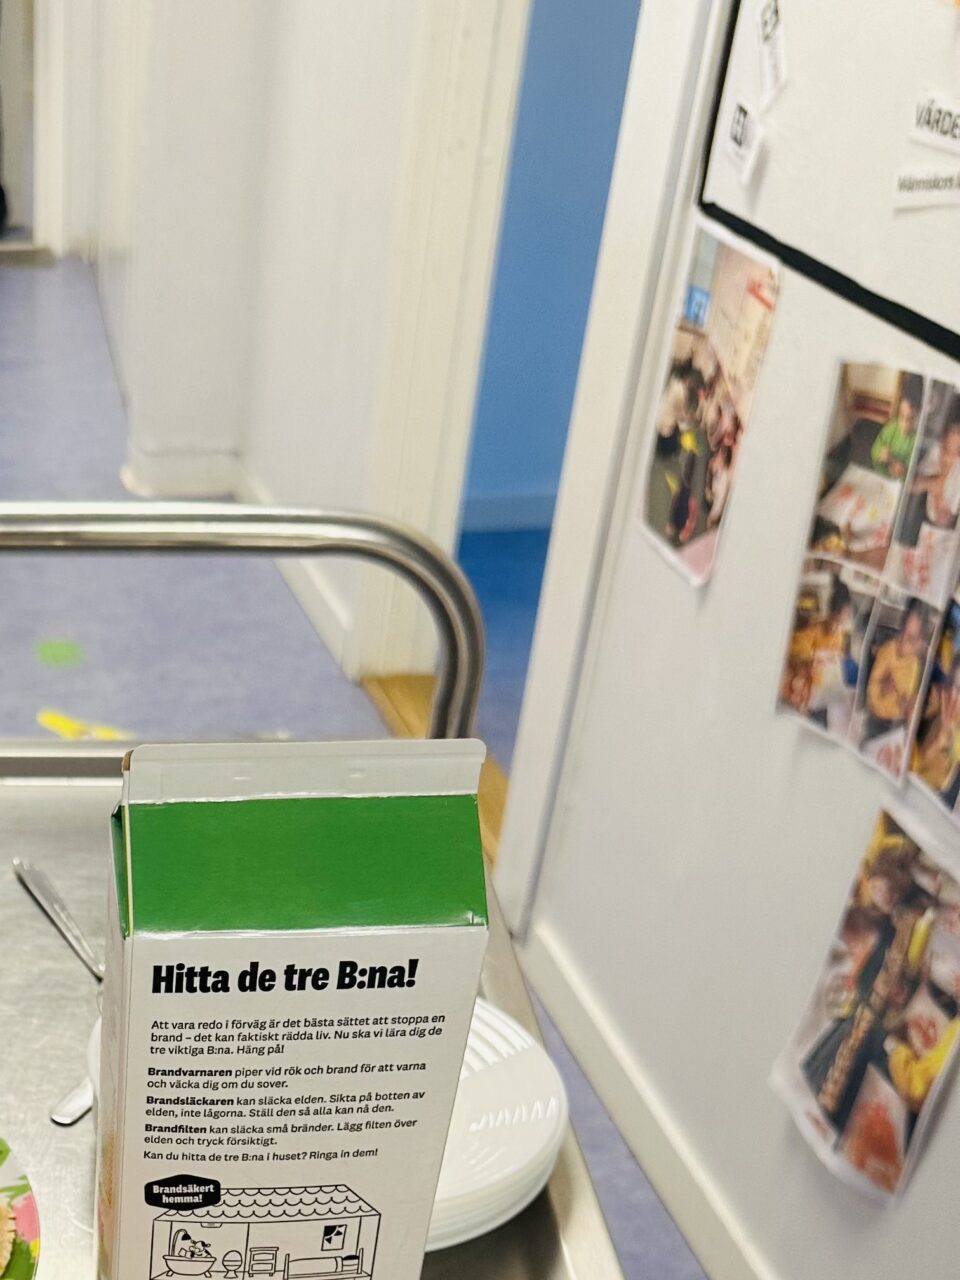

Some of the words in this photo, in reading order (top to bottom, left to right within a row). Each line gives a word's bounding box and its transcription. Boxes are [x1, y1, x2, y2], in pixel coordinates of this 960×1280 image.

[152, 963, 230, 994] Hitta
[237, 961, 276, 993] de
[283, 964, 329, 991] tre
[336, 958, 419, 989] B:na!
[151, 1020, 169, 1030] Att
[171, 1022, 195, 1030] vara
[198, 1020, 222, 1030] redo
[226, 1020, 229, 1029] i
[231, 1020, 266, 1030] förväg
[269, 1019, 280, 1028] är
[282, 1018, 300, 1028] det
[304, 1018, 334, 1027] bästa
[337, 1017, 370, 1026] sättet
[372, 1016, 388, 1025] att
[391, 1016, 429, 1025] stoppa
[150, 1033, 182, 1042] brand
[194, 1033, 212, 1042] det
[215, 1033, 234, 1042] kan
[237, 1032, 279, 1042] faktiskt
[282, 1031, 313, 1040] rädda
[316, 1030, 331, 1040] liv.
[334, 1030, 349, 1039] Nu
[352, 1029, 370, 1038] ska
[374, 1029, 383, 1038] vi
[386, 1028, 406, 1037] lära
[409, 1027, 426, 1038] dig
[428, 1027, 442, 1035] de
[150, 1046, 166, 1054] tre
[168, 1046, 204, 1056] viktiga
[207, 1046, 234, 1054] B:na.
[237, 1045, 265, 1055] Häng
[267, 1044, 284, 1055] på!
[148, 1068, 232, 1076] Brandvarnaren
[235, 1069, 263, 1078] piper
[265, 1067, 282, 1076] vid
[284, 1066, 302, 1075] rök
[304, 1066, 323, 1074] och
[326, 1065, 358, 1074] brand
[360, 1064, 376, 1073] för
[378, 1064, 394, 1072] att
[396, 1063, 426, 1071] varna
[147, 1080, 166, 1088] och
[170, 1080, 200, 1088] väcka
[202, 1080, 219, 1090] dig
[221, 1081, 238, 1089] om
[241, 1080, 254, 1088] du
[146, 1096, 234, 1106] Brandsläckaren
[236, 1097, 255, 1106] kan
[258, 1096, 292, 1104] släcka
[294, 1095, 326, 1104] elden.
[330, 1094, 356, 1103] Sikta
[359, 1092, 372, 1103] på
[375, 1092, 410, 1101] botten
[412, 1091, 425, 1099] av
[146, 1108, 178, 1118] elden,
[181, 1109, 201, 1117] inte
[204, 1109, 246, 1119] lågorna.
[249, 1108, 273, 1117] Ställ
[276, 1108, 296, 1116] den
[298, 1107, 310, 1116] så
[313, 1106, 332, 1115] alla
[335, 1106, 354, 1114] kan
[356, 1104, 369, 1113] nå
[372, 1104, 394, 1113] den.
[145, 1124, 206, 1133] Brandfilten
[210, 1125, 228, 1134] kan
[231, 1125, 264, 1134] släcka
[266, 1124, 288, 1133] små
[291, 1123, 334, 1133] bränder.
[337, 1123, 362, 1132] Lägg
[365, 1121, 391, 1130] filten
[394, 1119, 417, 1128] över
[144, 1136, 173, 1144] elden
[176, 1137, 194, 1145] och
[197, 1137, 224, 1147] tryck
[226, 1136, 277, 1146] försiktigt.
[144, 1151, 163, 1159] Kan
[166, 1152, 179, 1160] du
[182, 1152, 206, 1161] hitta
[208, 1153, 221, 1161] de
[224, 1153, 239, 1161] tre
[242, 1153, 264, 1161] B:na
[272, 1152, 308, 1161] huset?
[309, 1150, 338, 1160] Ringa
[340, 1150, 350, 1158] in
[352, 1148, 378, 1157] dem!
[153, 1184, 214, 1193] Brandsäkert
[162, 1194, 202, 1203] hemma!
